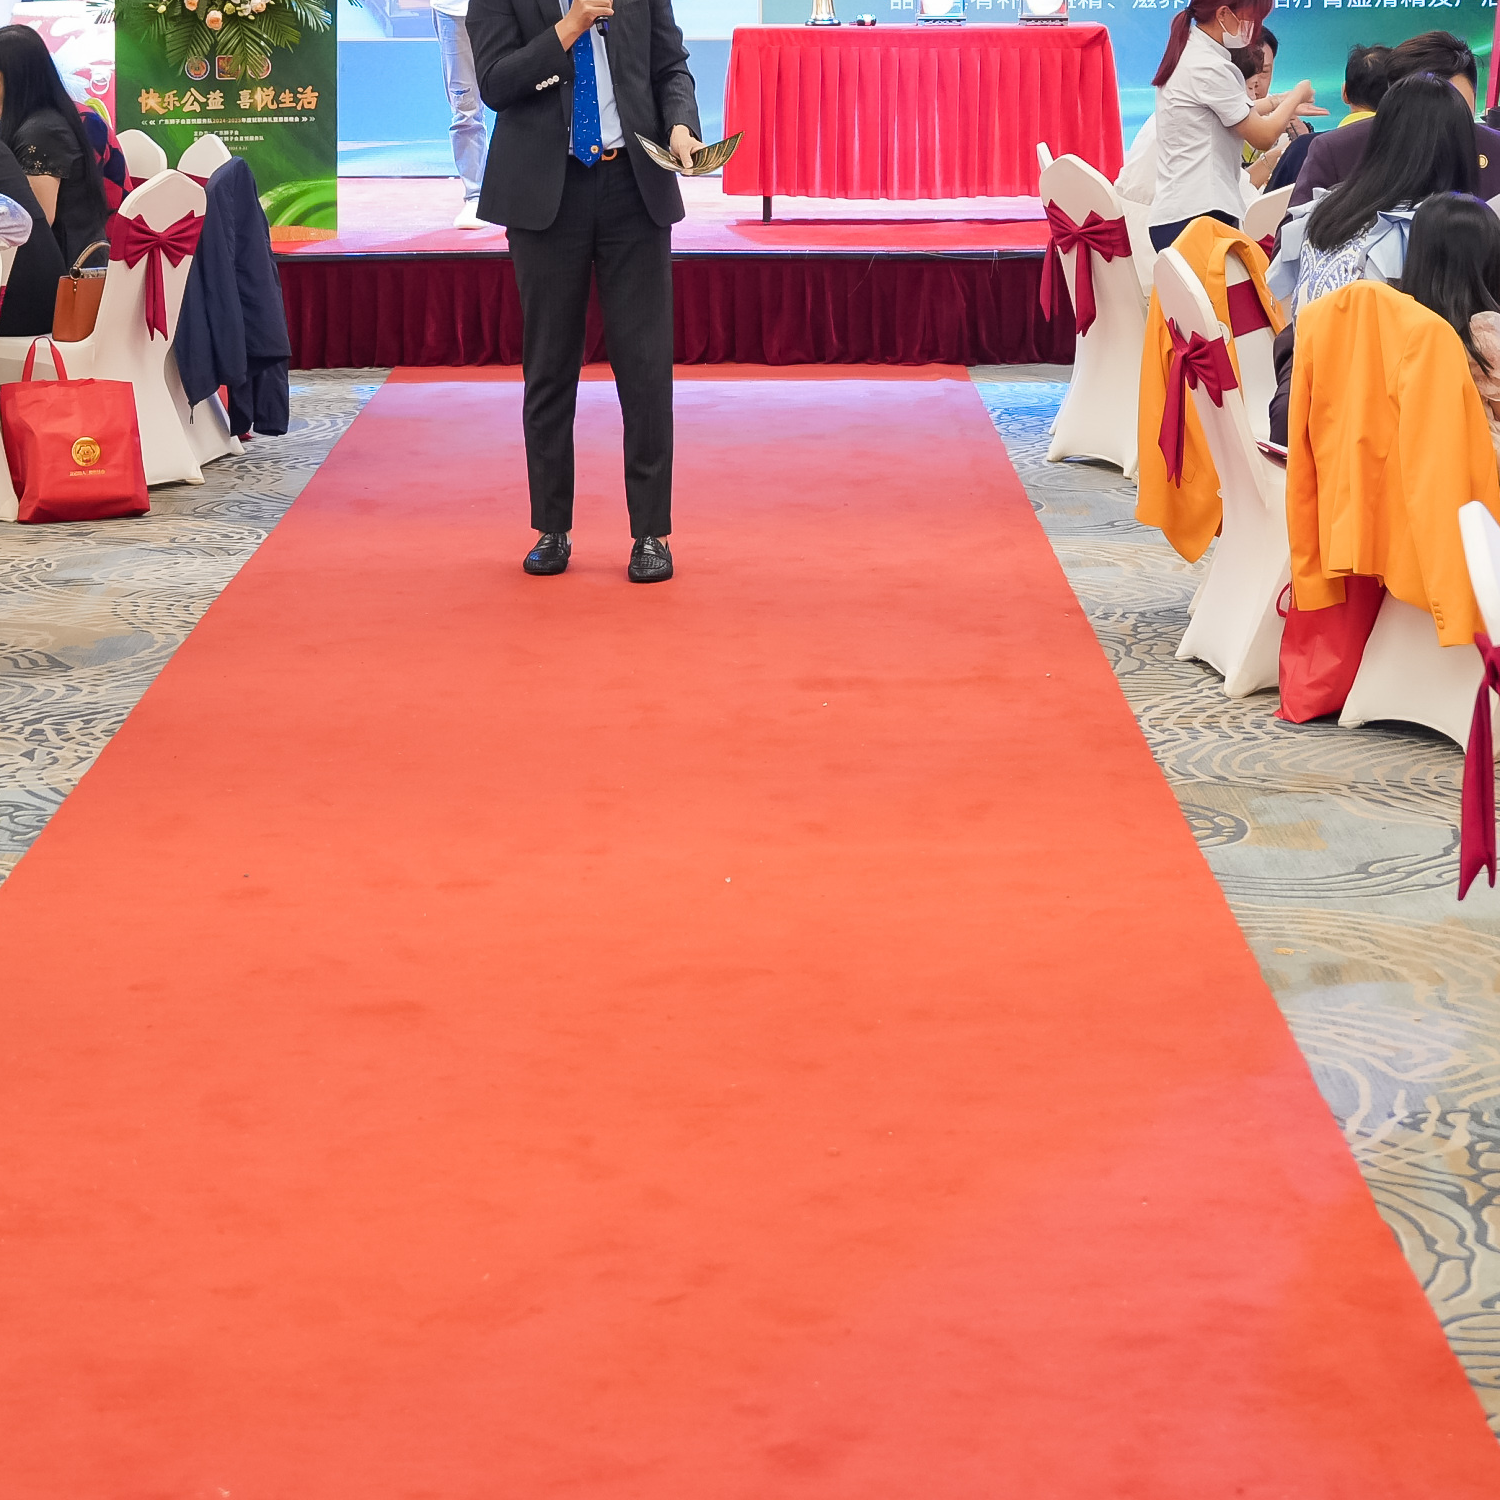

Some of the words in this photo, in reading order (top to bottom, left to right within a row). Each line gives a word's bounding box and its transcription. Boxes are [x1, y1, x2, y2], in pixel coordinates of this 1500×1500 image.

[138, 87, 225, 115] 快乐公益
[236, 85, 319, 112] 喜悦生活
